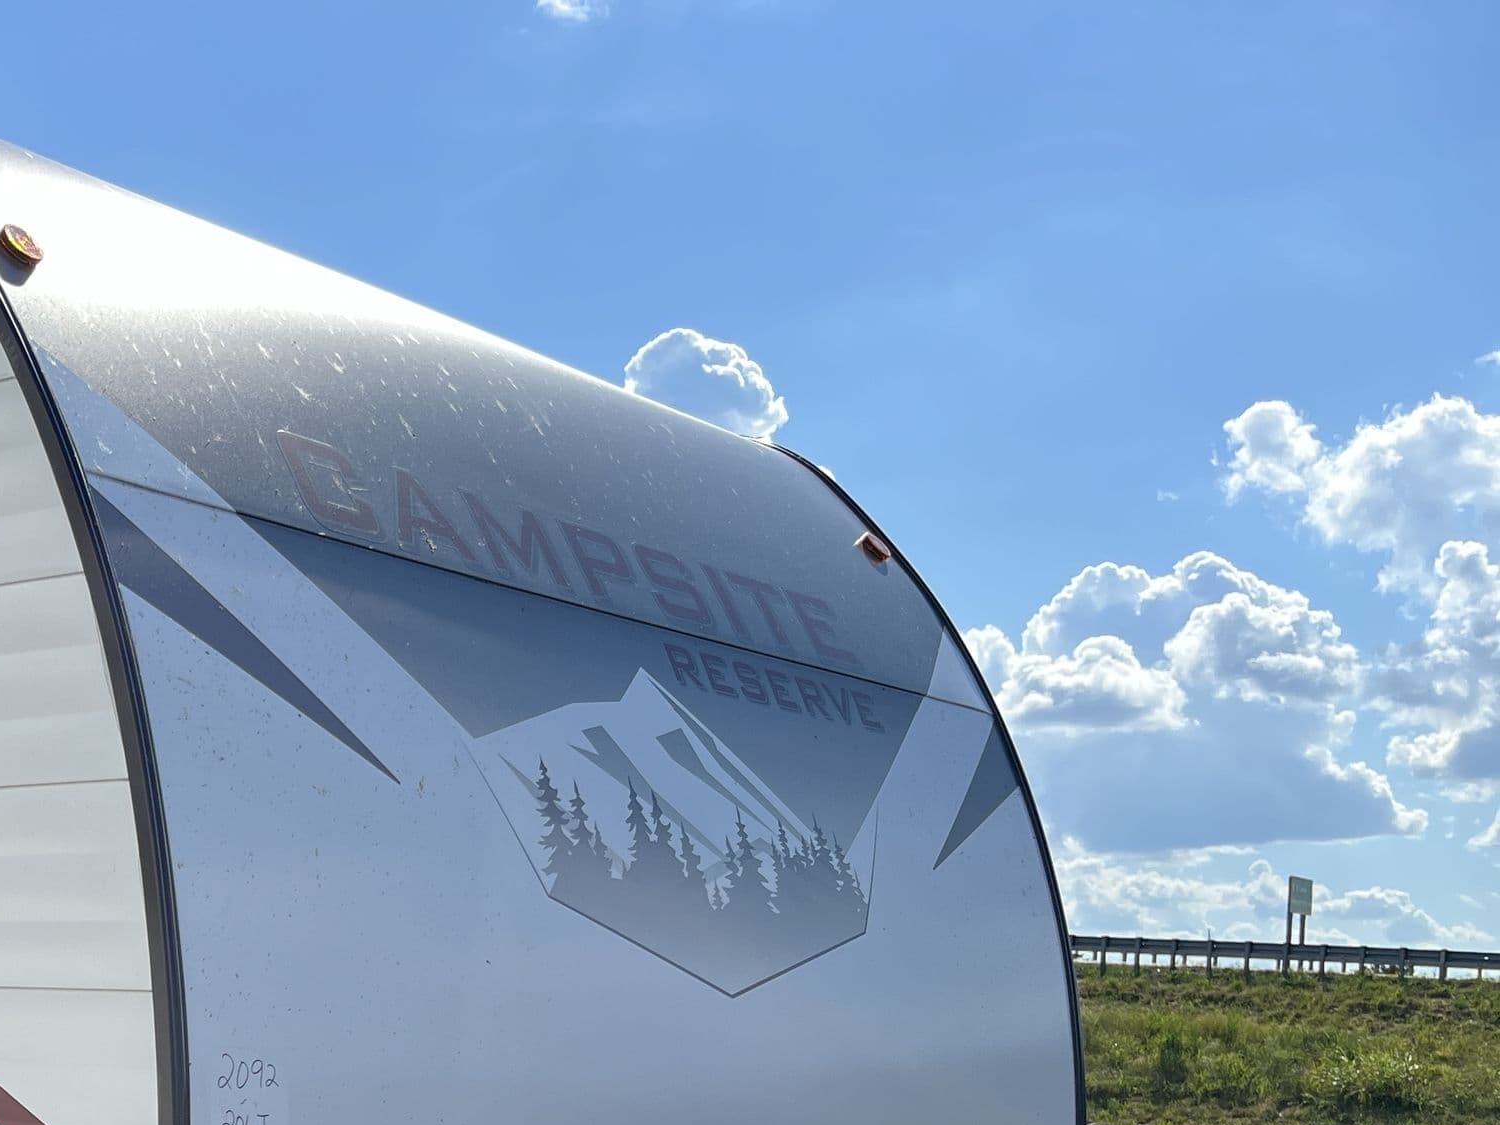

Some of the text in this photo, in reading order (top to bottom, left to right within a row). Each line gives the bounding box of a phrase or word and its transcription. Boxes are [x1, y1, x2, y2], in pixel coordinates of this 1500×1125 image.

[276, 429, 862, 664] CAMPSITE
[662, 642, 887, 734] RESERVE
[217, 1052, 279, 1089] 2092
